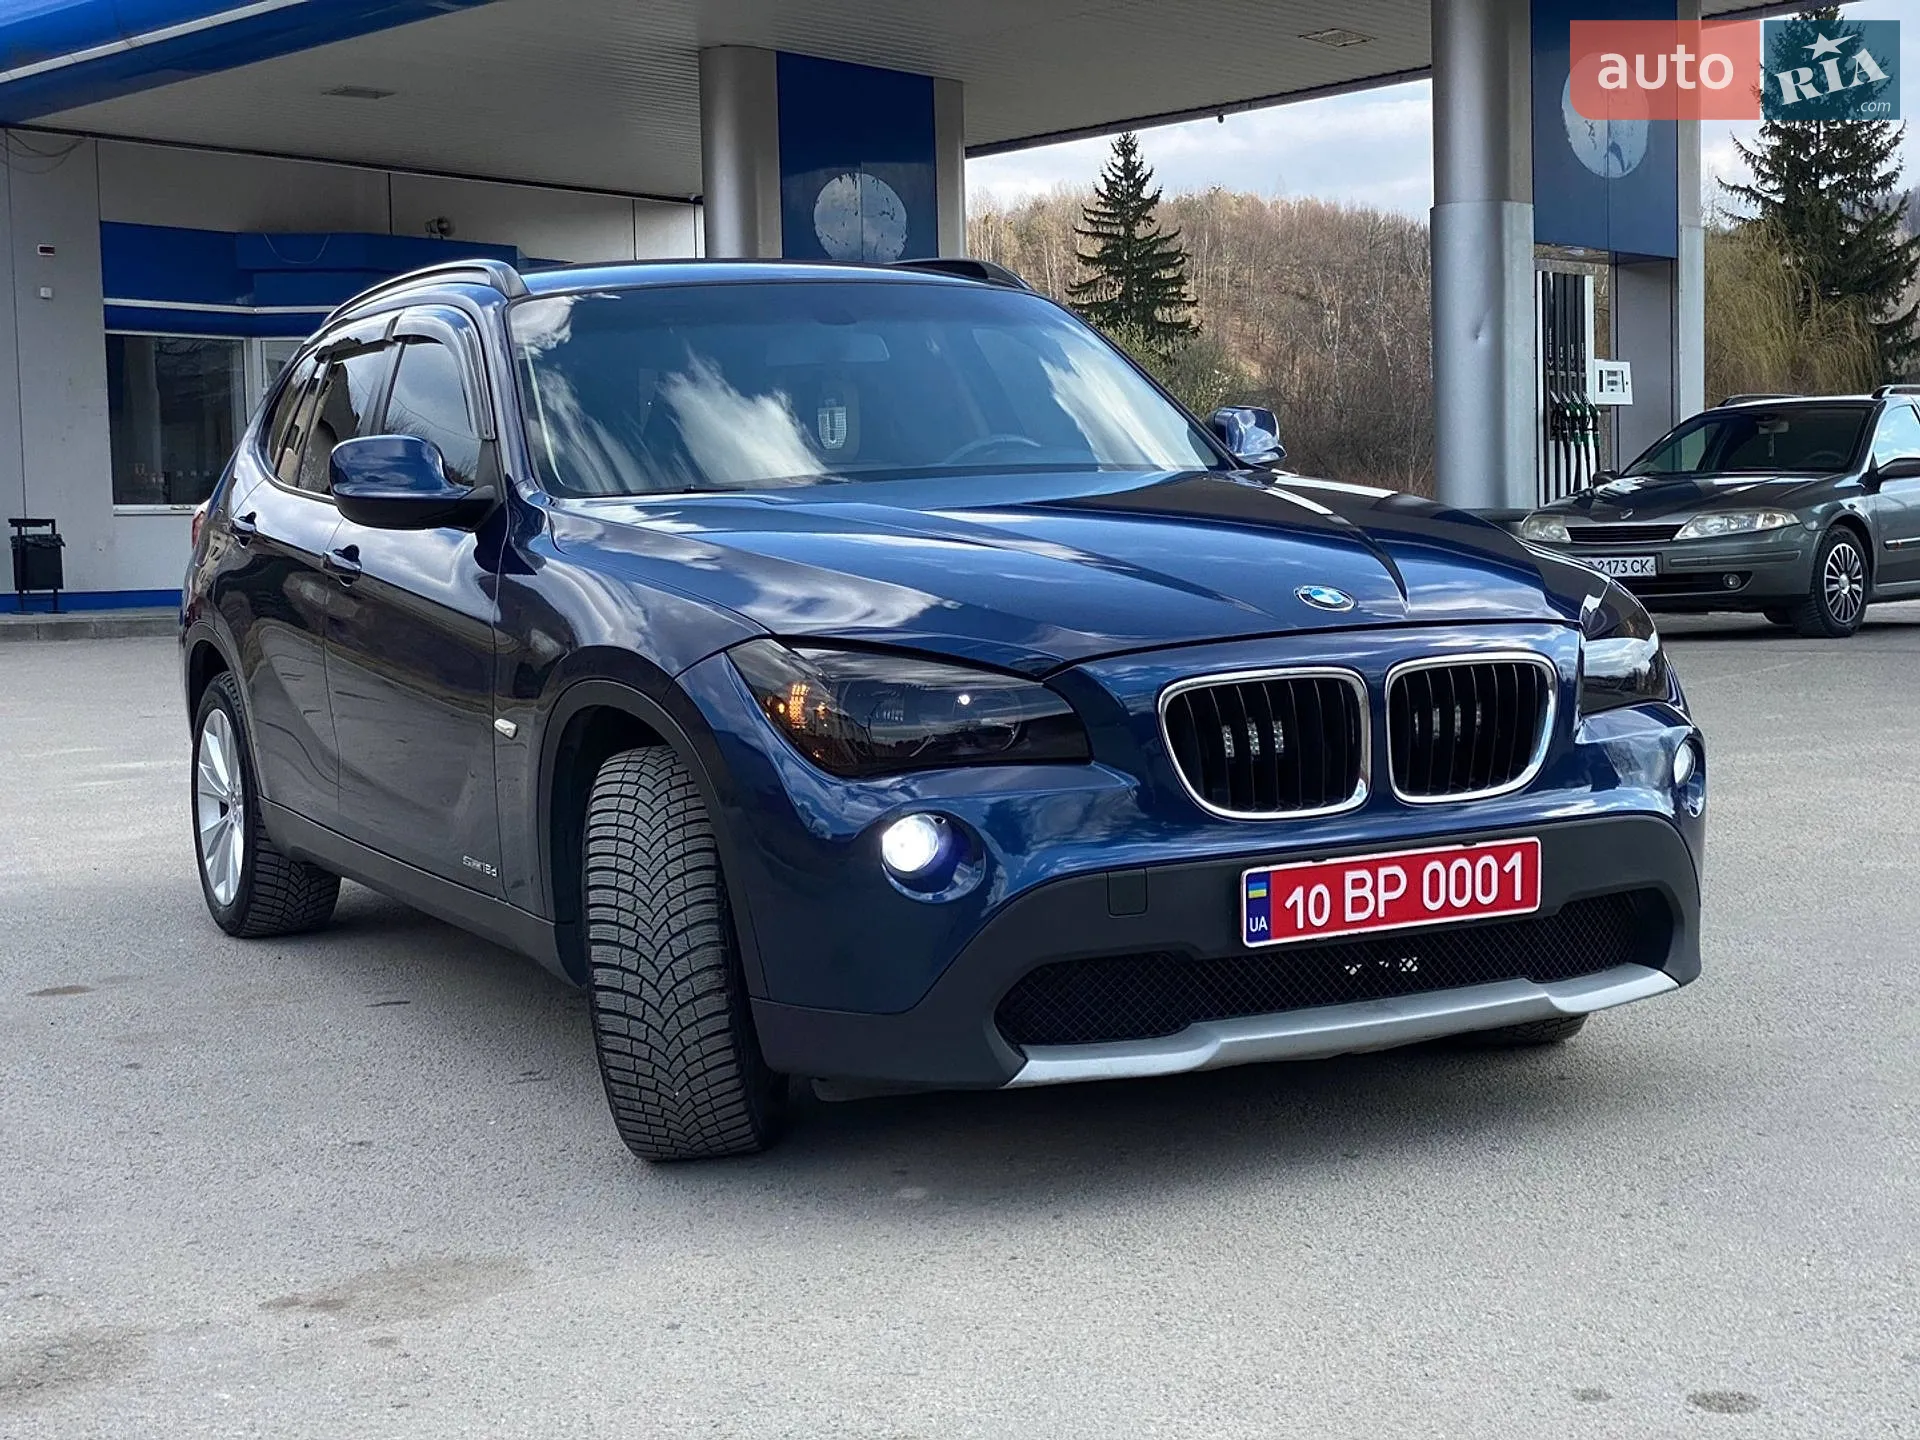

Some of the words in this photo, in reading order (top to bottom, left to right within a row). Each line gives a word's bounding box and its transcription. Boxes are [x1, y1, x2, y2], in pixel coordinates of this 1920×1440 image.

[1630, 559, 1650, 573] CK
[1284, 883, 1331, 929] 10
[1343, 864, 1408, 923] BP
[1422, 850, 1523, 912] 0001
[1249, 916, 1268, 932] UA
